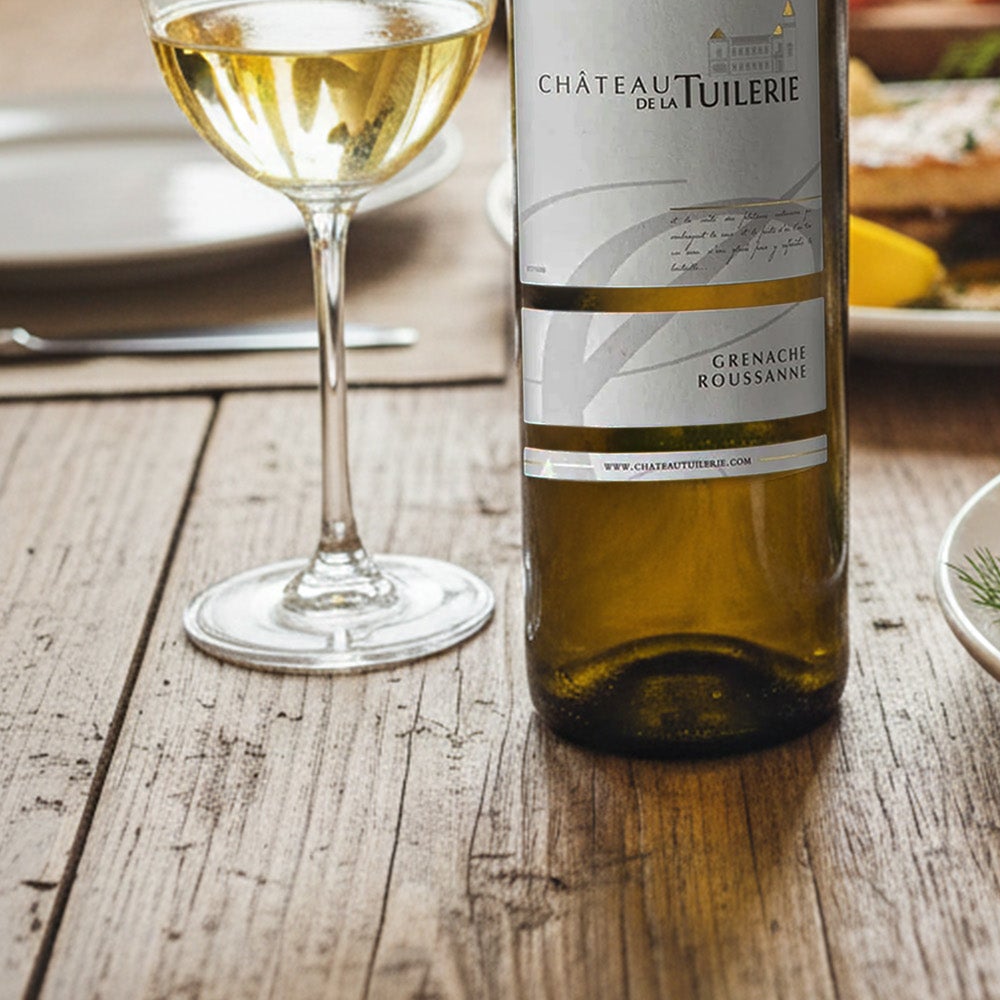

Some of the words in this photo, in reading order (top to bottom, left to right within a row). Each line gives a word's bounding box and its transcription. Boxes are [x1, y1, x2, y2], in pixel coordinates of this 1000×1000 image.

[538, 70, 670, 95] CHÂTEAU
[674, 73, 800, 109] TUILERIE
[636, 97, 655, 110] DE
[660, 96, 678, 109] LA
[712, 345, 806, 369] GRENACHE
[698, 364, 807, 388] ROUSSANNE
[604, 457, 752, 472] WWW.CHATEAUTUILERIE.COM
